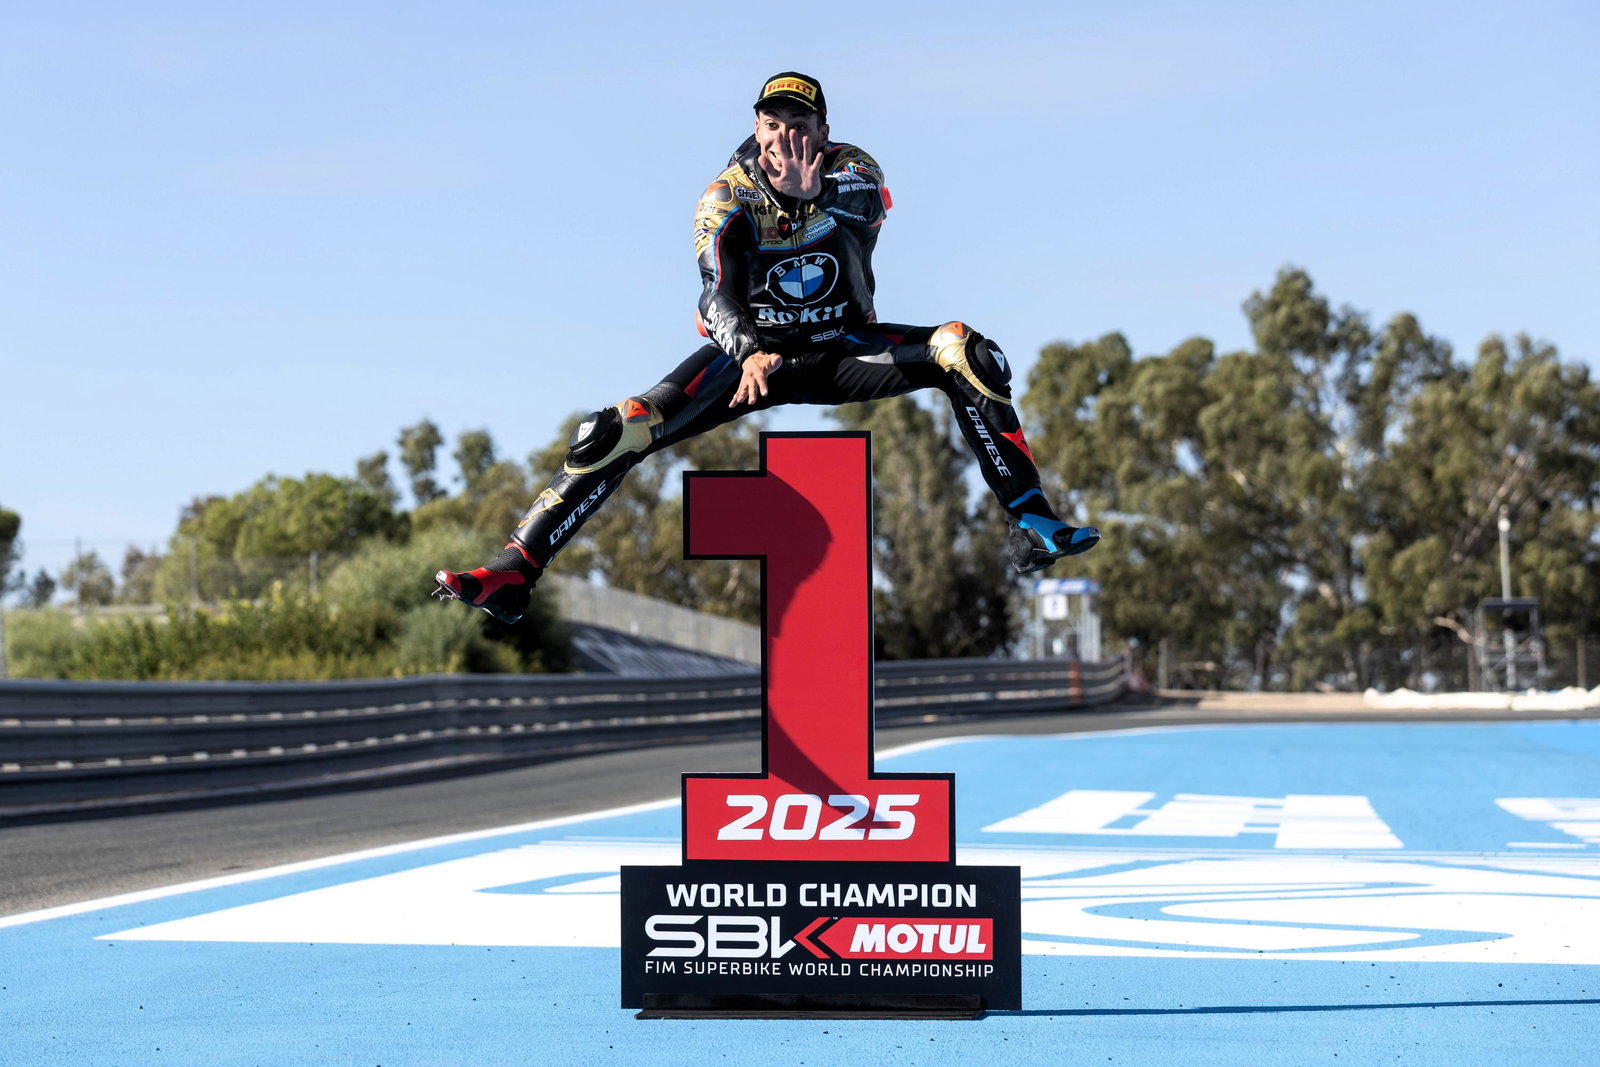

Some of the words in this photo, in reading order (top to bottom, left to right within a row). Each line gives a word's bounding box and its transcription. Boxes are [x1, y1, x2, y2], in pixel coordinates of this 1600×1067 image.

[767, 80, 813, 97] PIRELLI
[737, 188, 760, 199] SHOEI
[774, 256, 828, 277] BMW
[810, 326, 847, 343] SBK
[965, 406, 1012, 477] DAINESE
[550, 480, 606, 546] DAINESE
[717, 794, 920, 841] 2025
[666, 883, 787, 907] WORLD
[799, 884, 976, 908] CHAMPION
[644, 914, 831, 959] SBK
[849, 923, 987, 954] MOTUL
[645, 961, 676, 974] FIM
[684, 961, 781, 976] SUPERBIKE
[788, 963, 851, 977] WORLD
[860, 964, 994, 978] CHAMPIONSHIP
